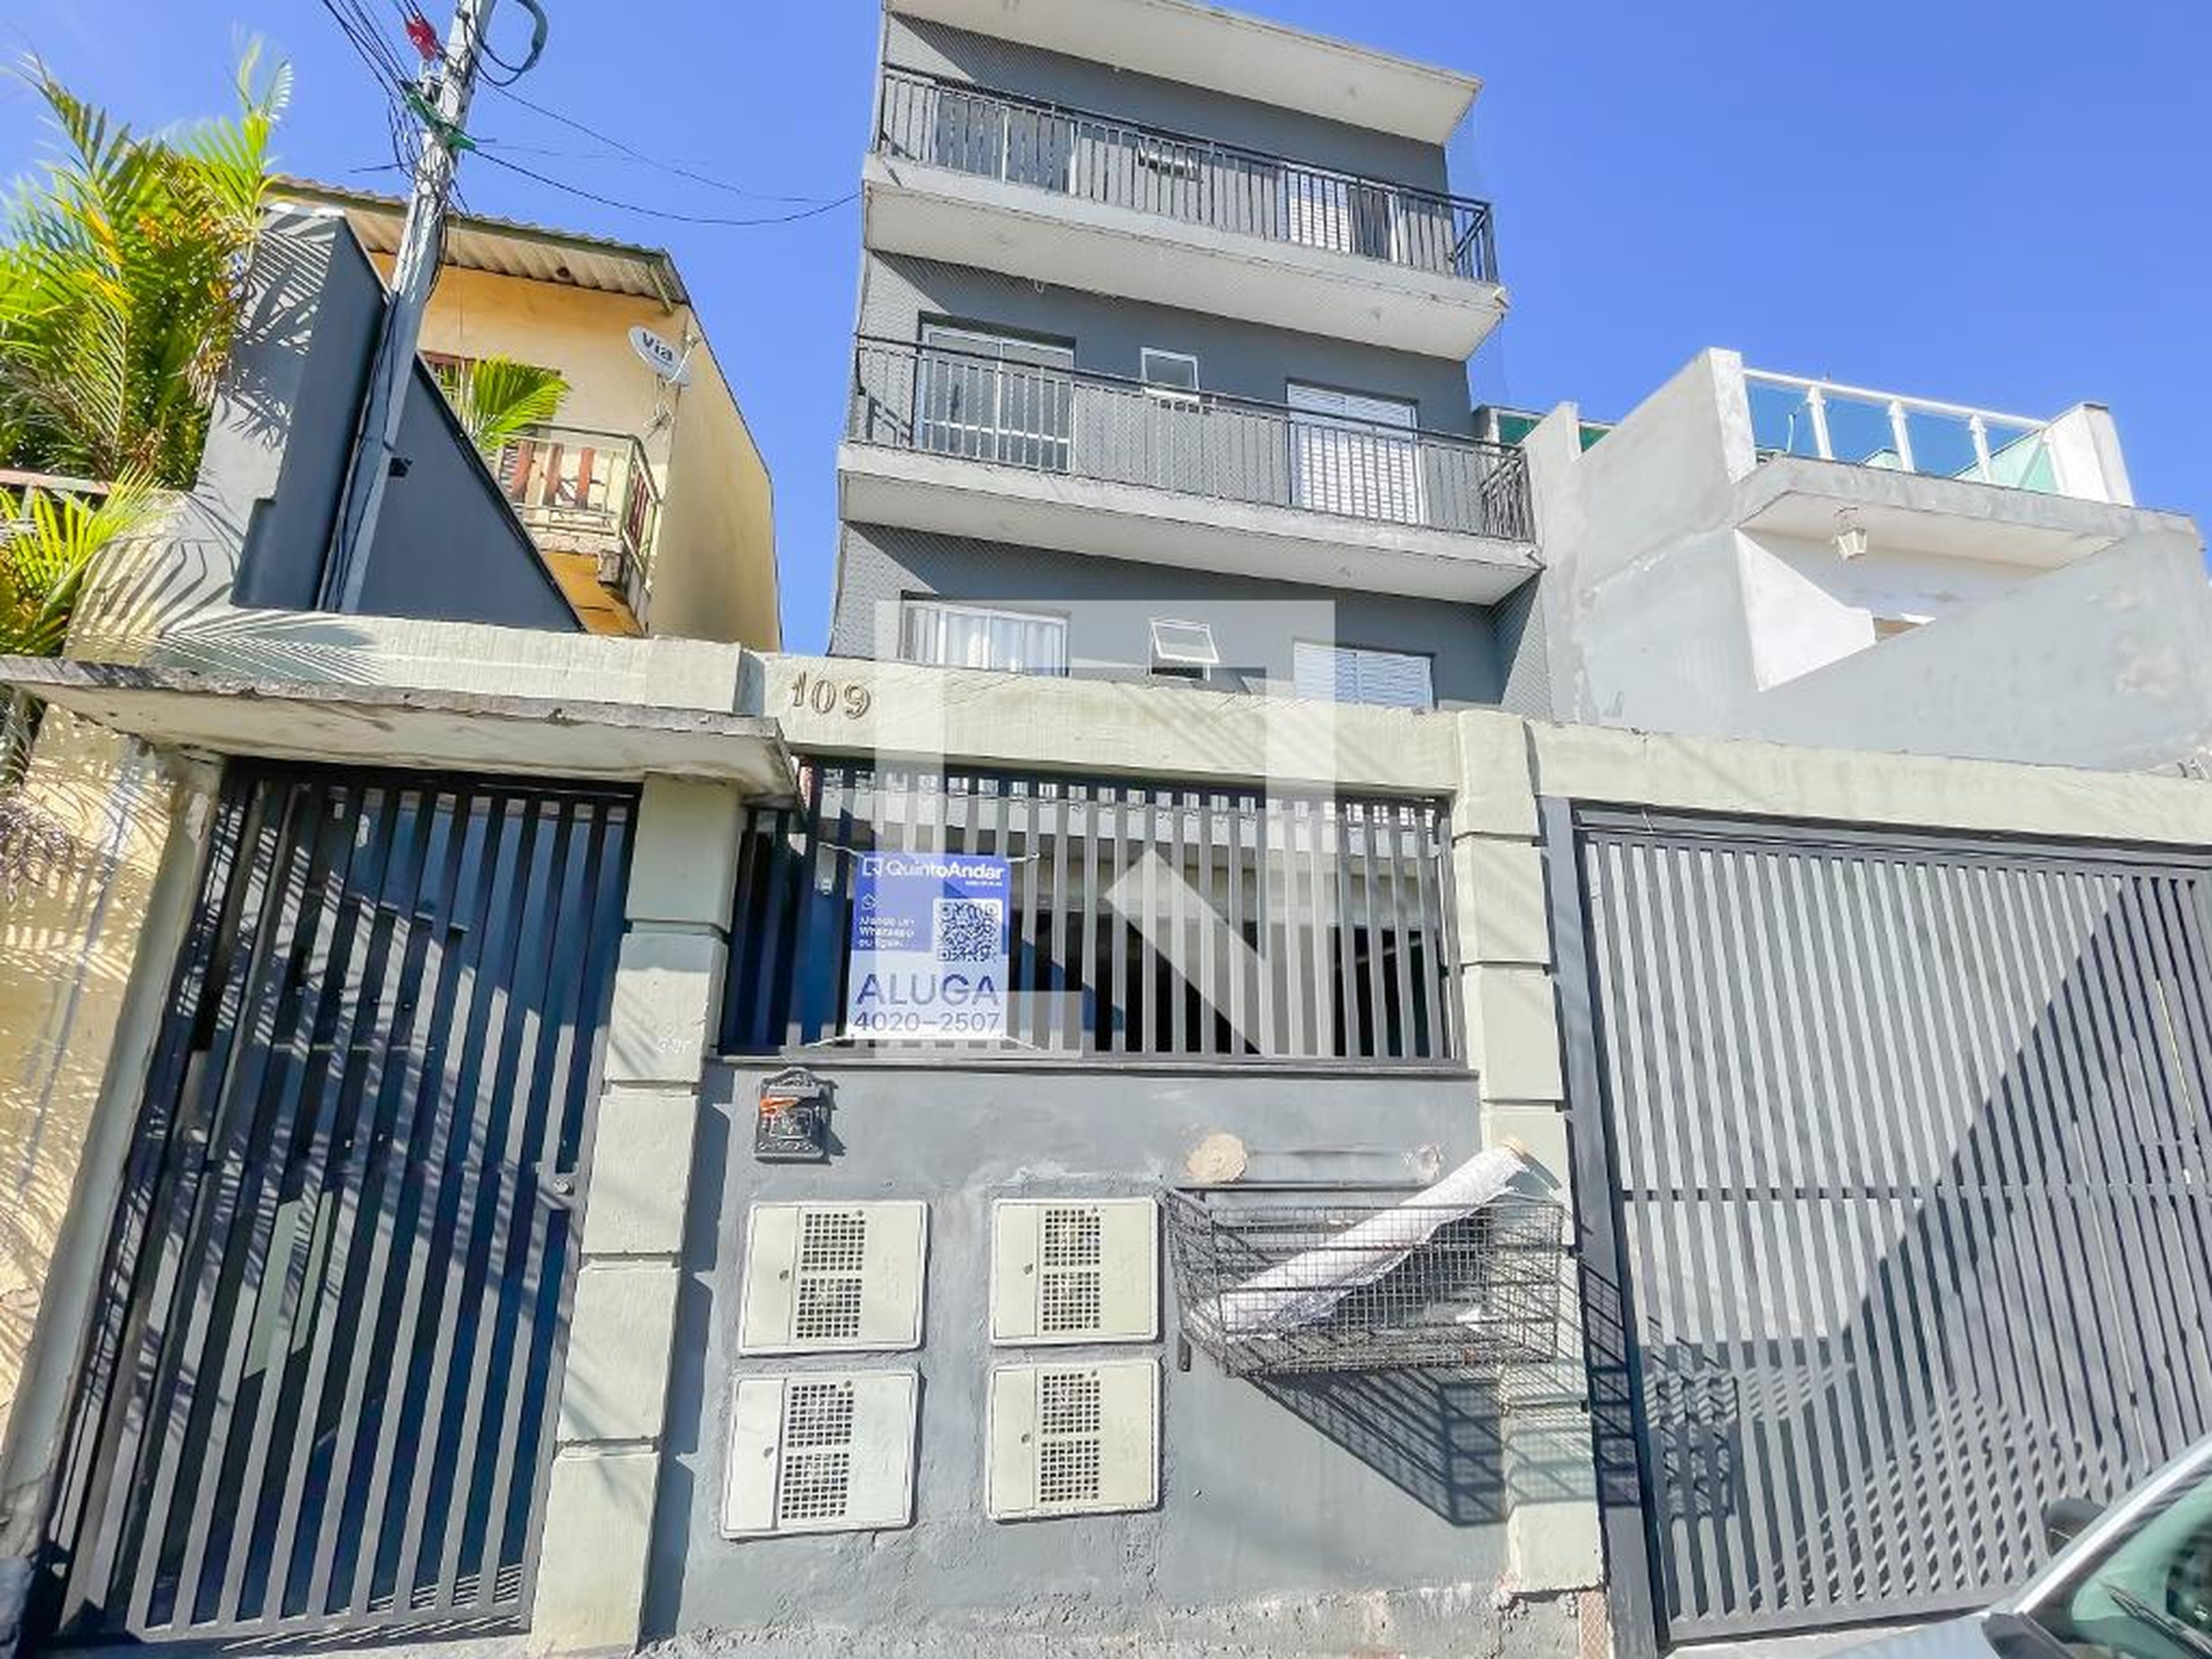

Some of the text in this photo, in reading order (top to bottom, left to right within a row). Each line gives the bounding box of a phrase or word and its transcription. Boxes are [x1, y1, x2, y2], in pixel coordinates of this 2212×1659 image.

[791, 671, 872, 719] 109
[887, 859, 1005, 880] QuintoAndar
[856, 974, 1000, 1006] ALUGA
[853, 1012, 1001, 1032] 4020-2507
